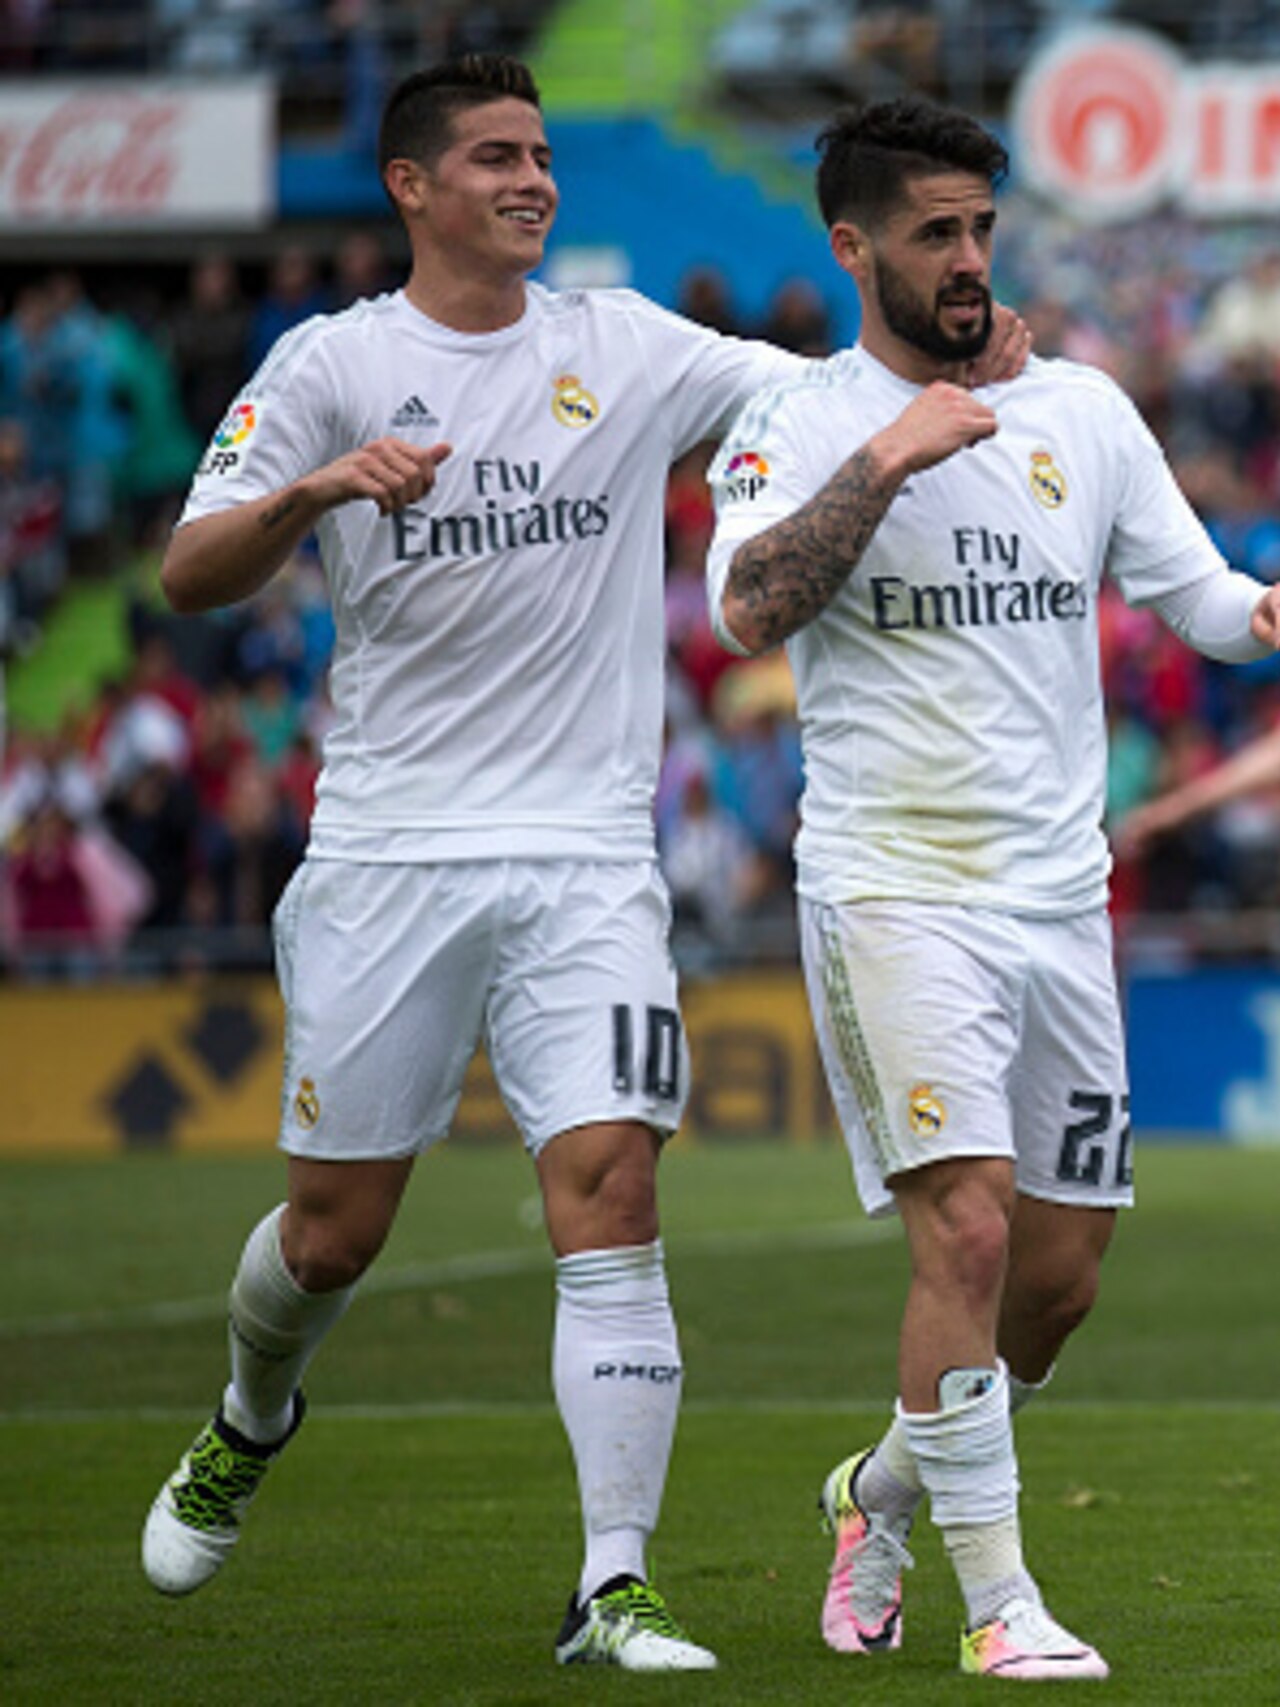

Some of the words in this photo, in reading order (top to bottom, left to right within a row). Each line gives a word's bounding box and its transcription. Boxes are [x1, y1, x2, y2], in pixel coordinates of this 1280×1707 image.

[473, 455, 540, 497] Fly
[392, 494, 610, 562] Emirates
[952, 525, 1019, 571] Fly
[869, 568, 1087, 630] Emirates
[612, 1004, 682, 1103] 10
